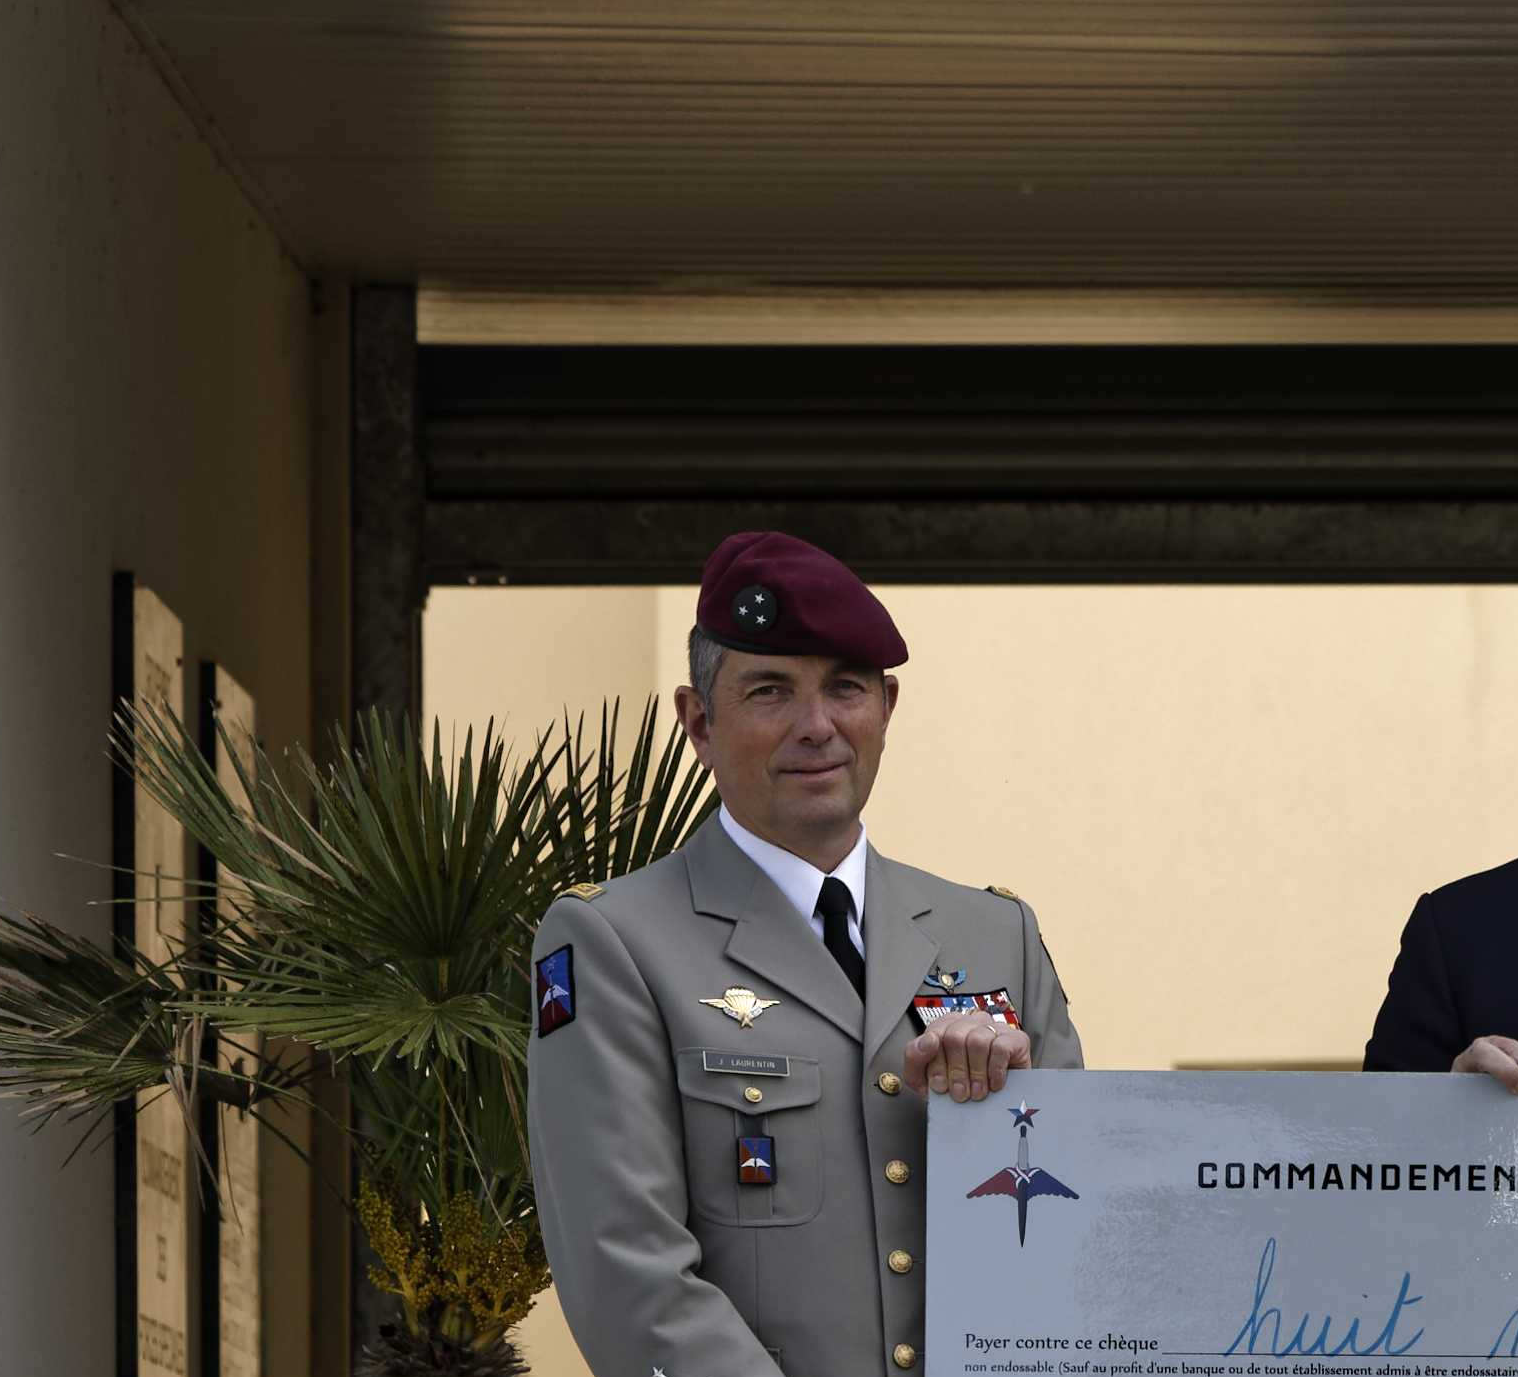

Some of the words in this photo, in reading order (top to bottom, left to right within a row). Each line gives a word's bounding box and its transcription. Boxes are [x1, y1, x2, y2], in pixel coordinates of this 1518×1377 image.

[1223, 1237, 1425, 1359] huit
[964, 1333, 1011, 1354] Payer
[1015, 1335, 1070, 1351] contre
[1074, 1337, 1093, 1351] ce
[1097, 1333, 1159, 1355] chèque
[964, 1363, 987, 1373] non
[990, 1361, 1055, 1374] endossable
[1058, 1361, 1090, 1375] (Sauf
[1092, 1364, 1107, 1375] au
[1110, 1362, 1144, 1377] profit
[1146, 1362, 1179, 1375] d'une
[1181, 1362, 1226, 1377] banque
[1228, 1365, 1244, 1376] ou
[1246, 1363, 1262, 1376] de
[1264, 1364, 1289, 1376] tout
[1292, 1362, 1373, 1376] établissement
[1375, 1364, 1412, 1377] admis
[1414, 1364, 1422, 1377] à
[1424, 1364, 1448, 1377] être
